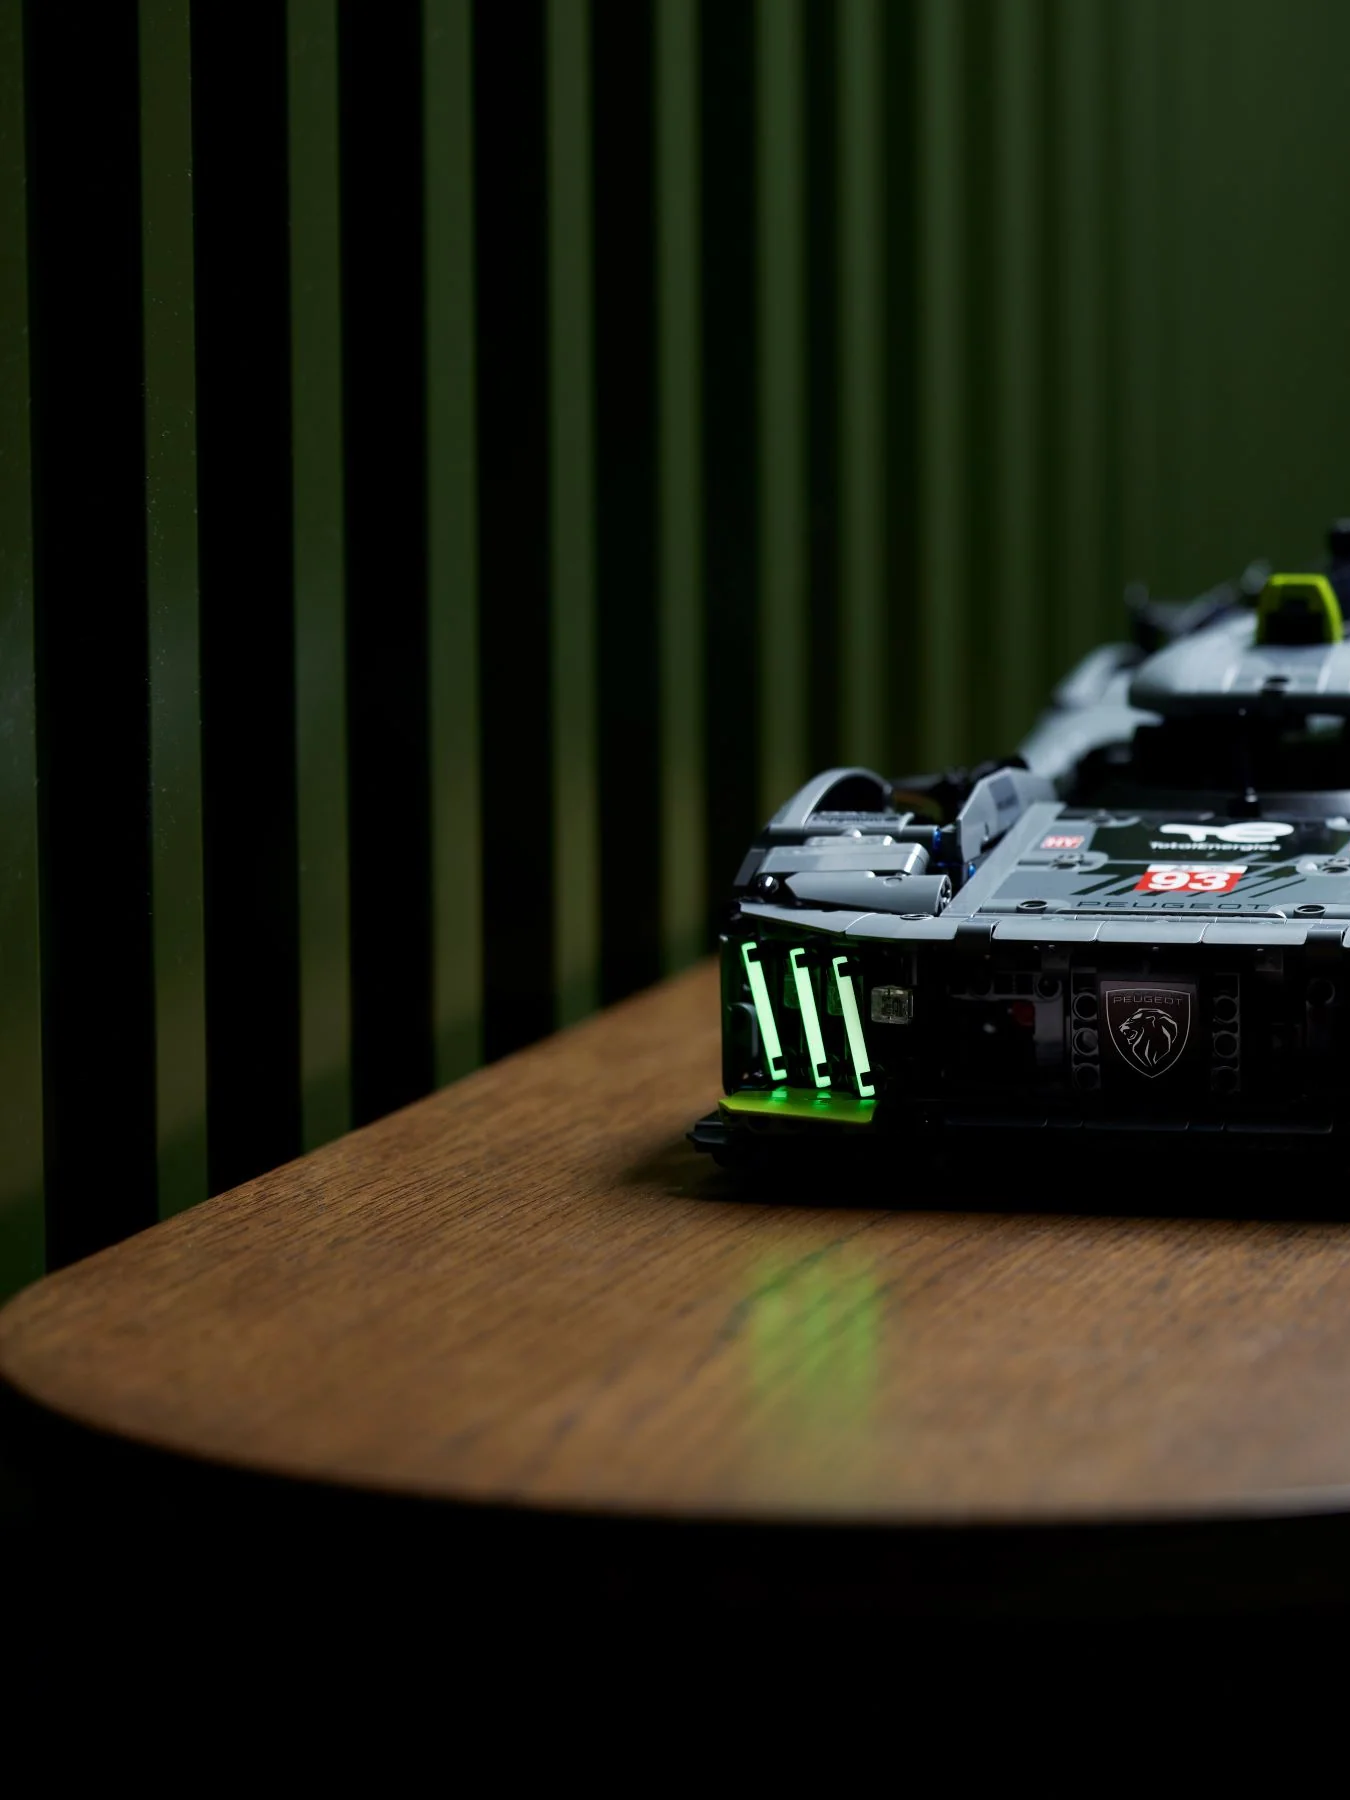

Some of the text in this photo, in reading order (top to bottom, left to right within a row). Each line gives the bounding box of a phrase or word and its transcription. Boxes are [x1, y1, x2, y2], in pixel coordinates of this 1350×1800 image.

[1150, 841, 1281, 852] TotalEnergies
[1148, 872, 1231, 891] 93
[1077, 901, 1270, 911] PEUGEOT
[1113, 995, 1183, 1006] PEUGEOT
